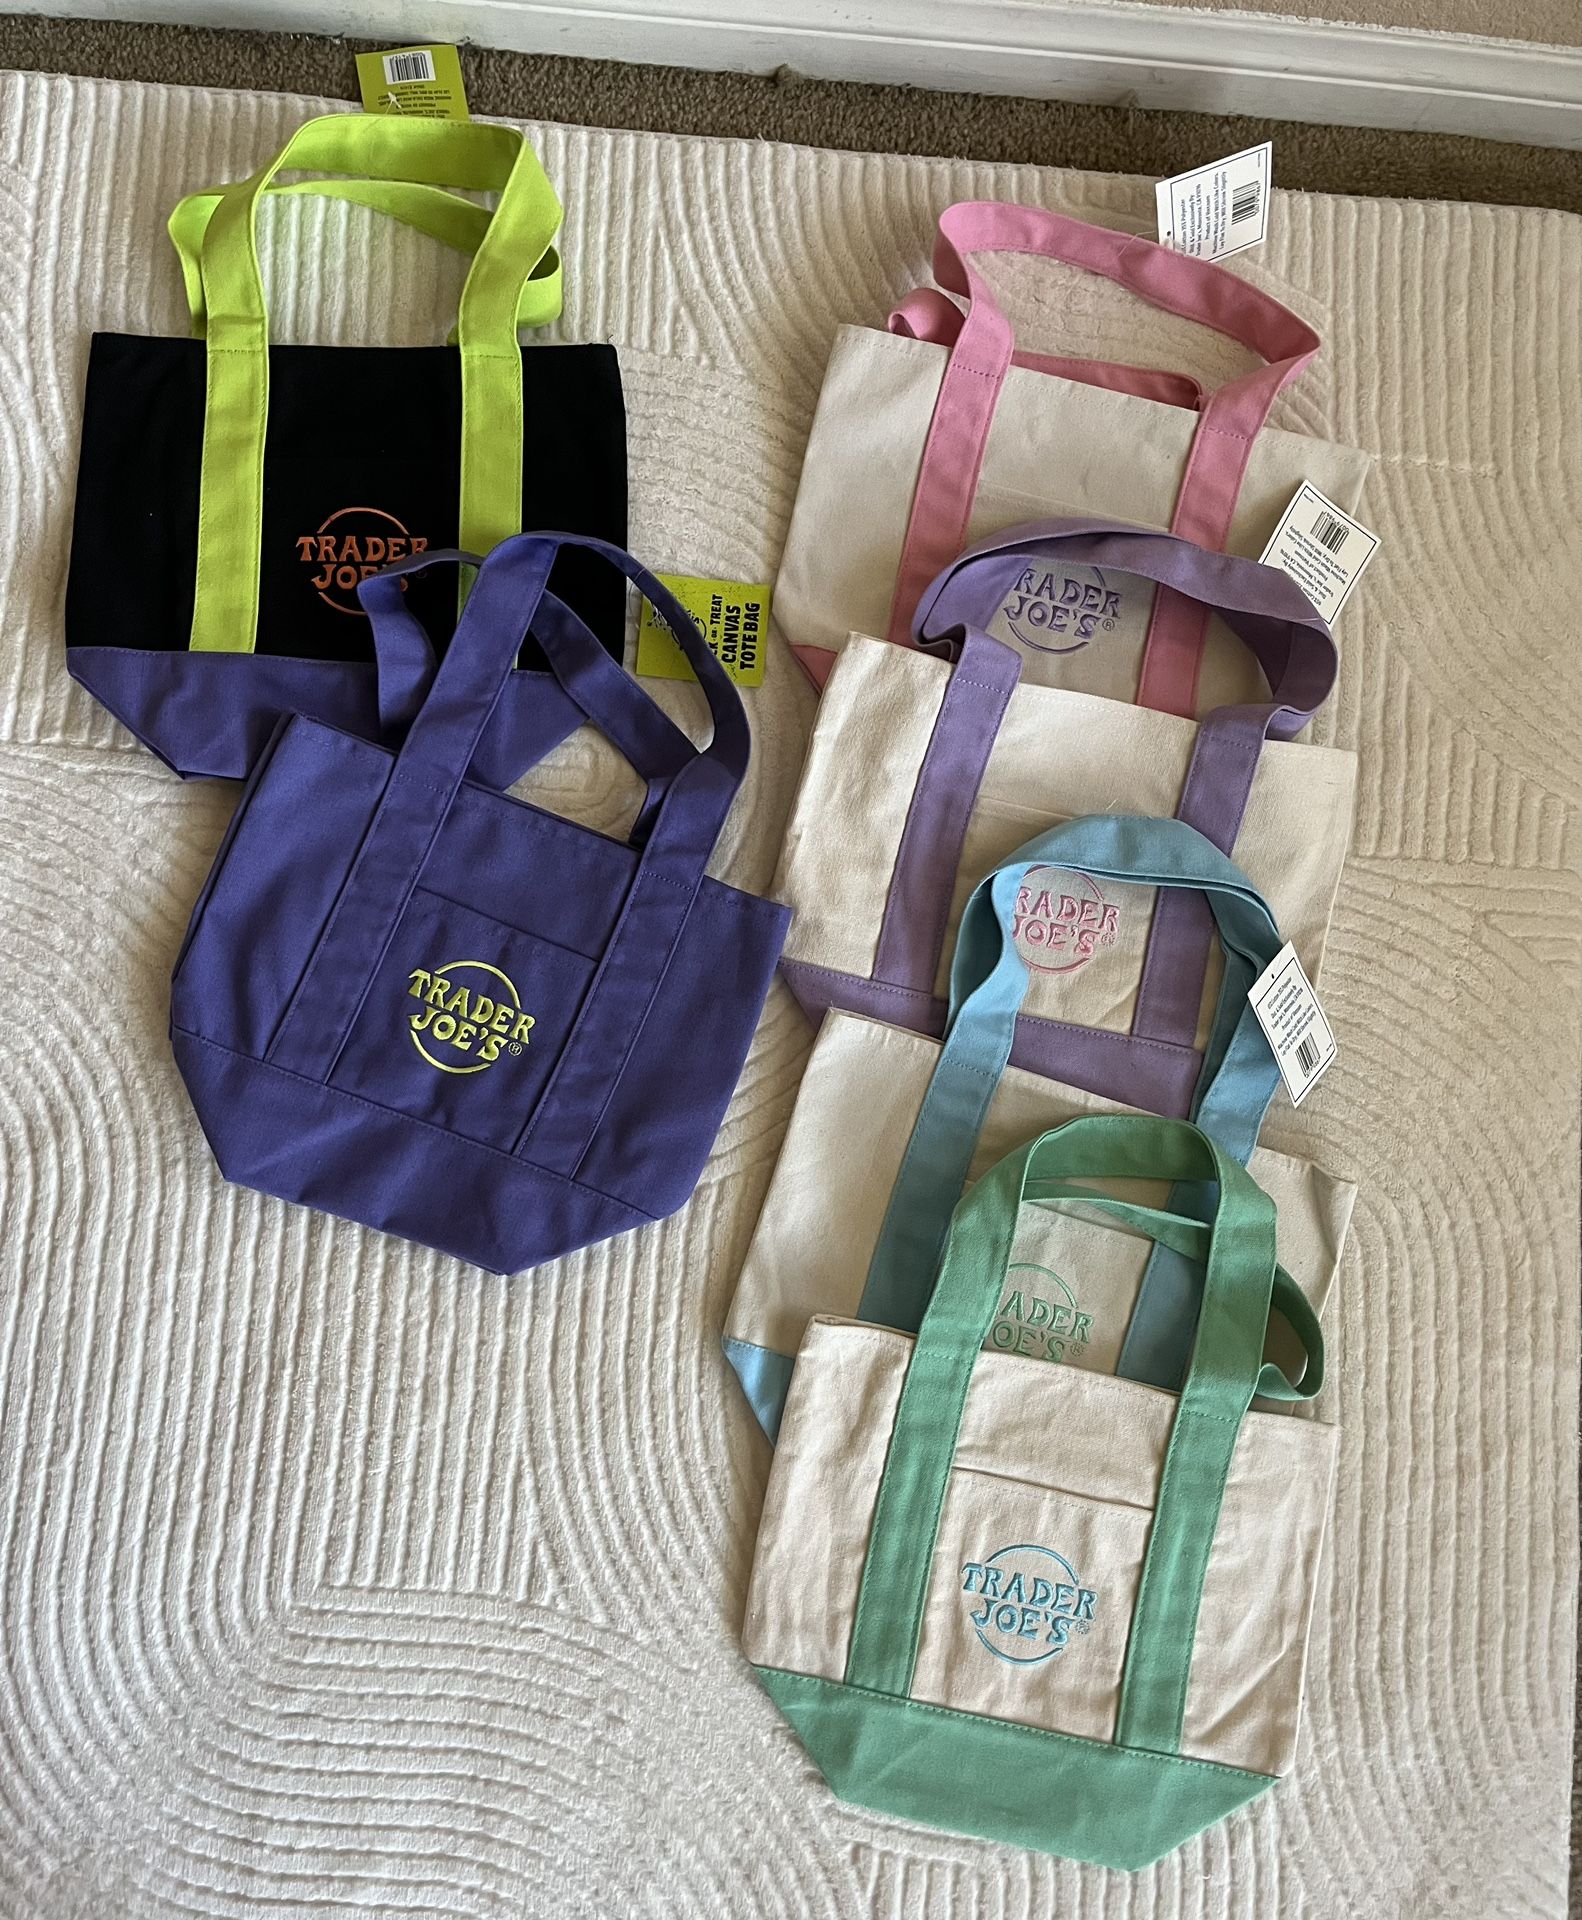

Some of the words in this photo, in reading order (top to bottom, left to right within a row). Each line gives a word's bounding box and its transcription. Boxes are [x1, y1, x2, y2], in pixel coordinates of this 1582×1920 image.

[296, 535, 428, 562] TRADER
[709, 594, 723, 626] TREAT
[1013, 567, 1122, 619] RADER
[721, 605, 742, 664] CANVAS
[744, 602, 761, 632] BAG
[1003, 595, 1102, 640] JOE'S
[740, 634, 758, 670] TOTE
[1015, 886, 1121, 933] RADER
[408, 968, 536, 1044] TRADER
[408, 1005, 509, 1062] JOE'S
[1000, 1290, 1095, 1344] ADER
[992, 1320, 1071, 1363] OE'S
[961, 1562, 1098, 1620] TRADER
[970, 1598, 1076, 1646] JOE'S
